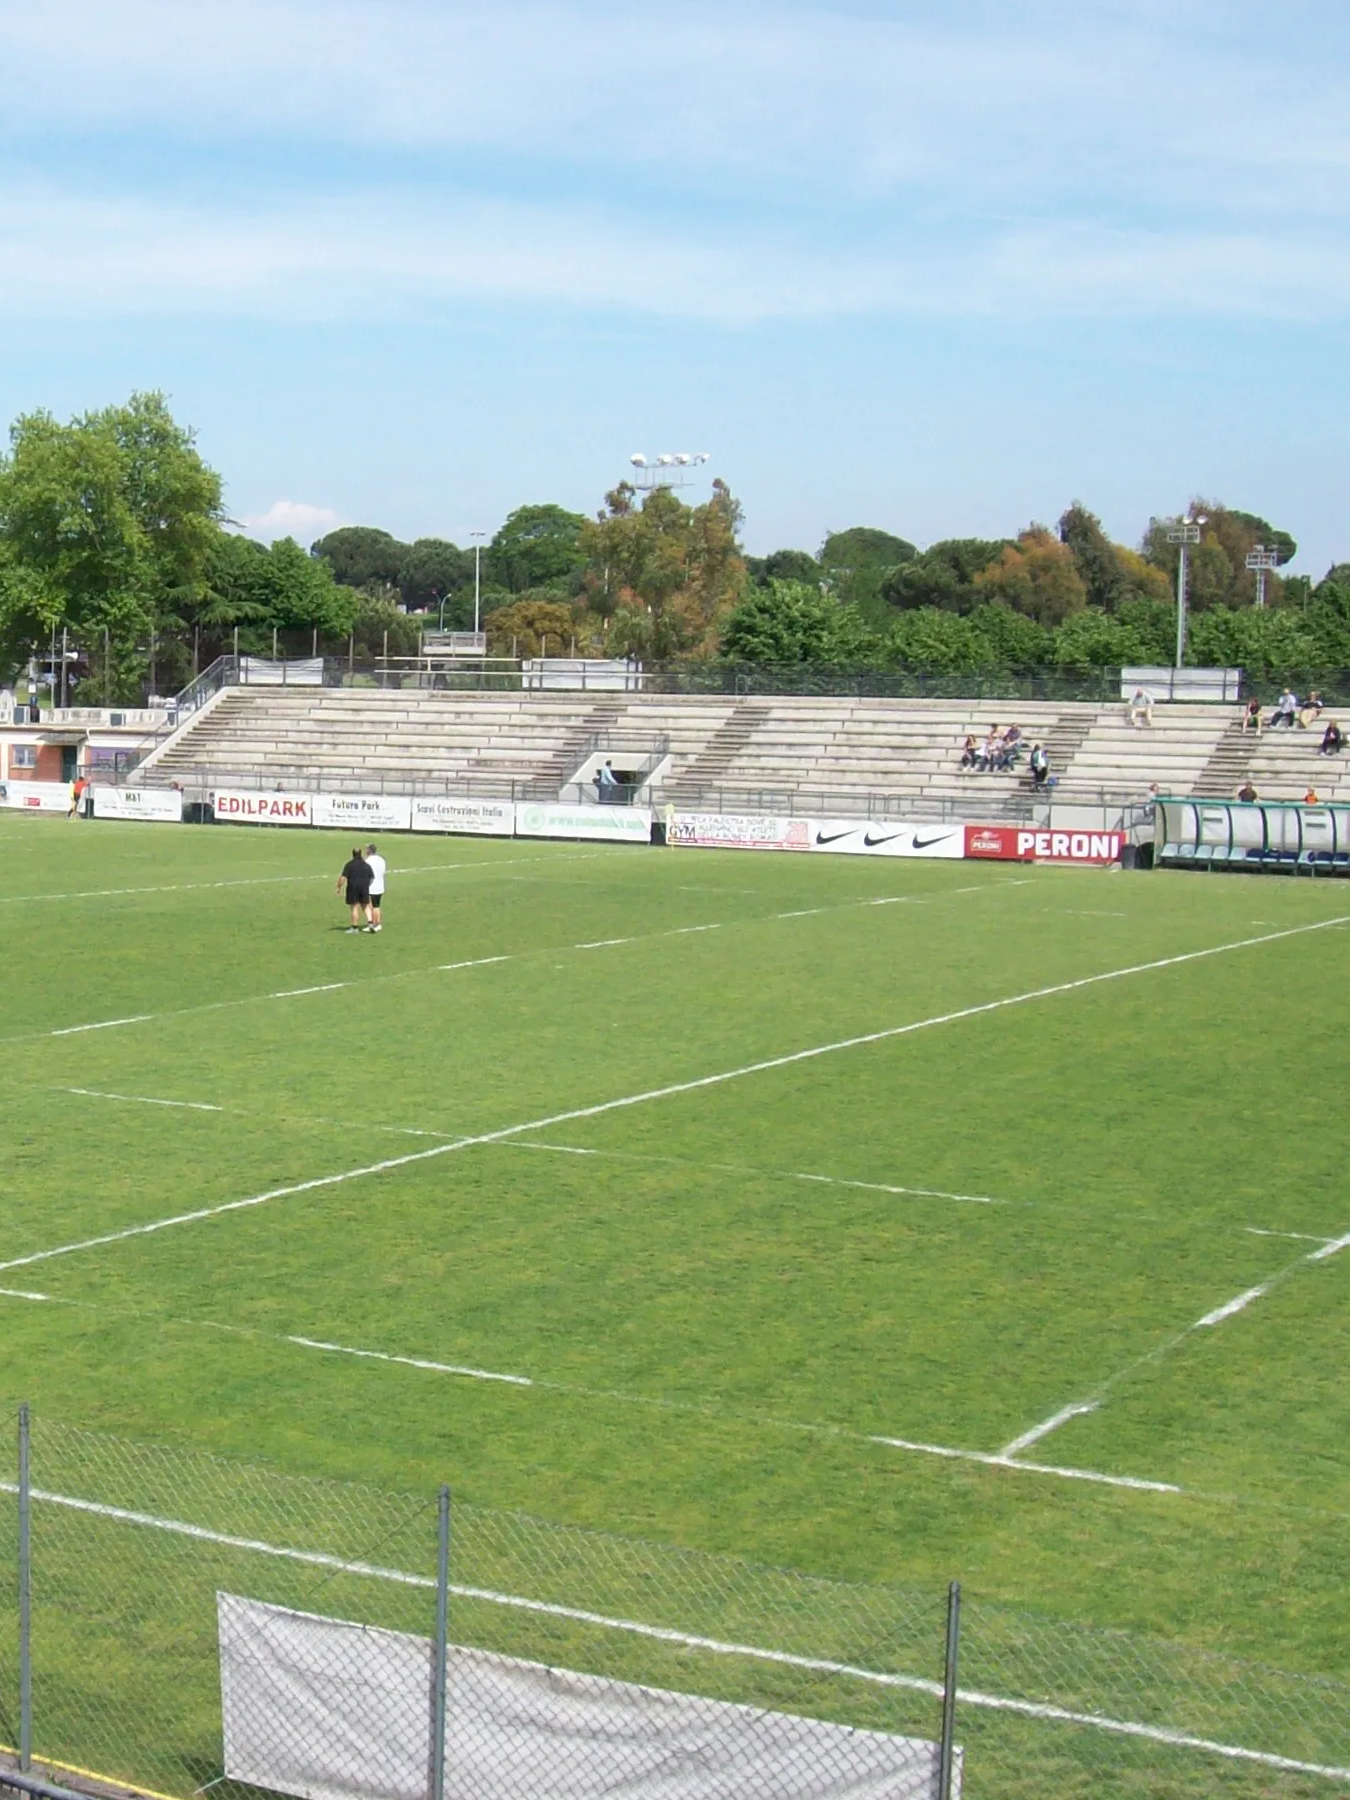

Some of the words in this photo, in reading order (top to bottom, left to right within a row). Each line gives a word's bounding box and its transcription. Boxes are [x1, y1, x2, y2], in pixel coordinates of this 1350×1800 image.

[217, 797, 308, 817] EDILPARK
[331, 798, 359, 811] Futura
[361, 799, 380, 811] Park
[669, 825, 696, 838] GYM
[1017, 831, 1119, 858] PERONI
